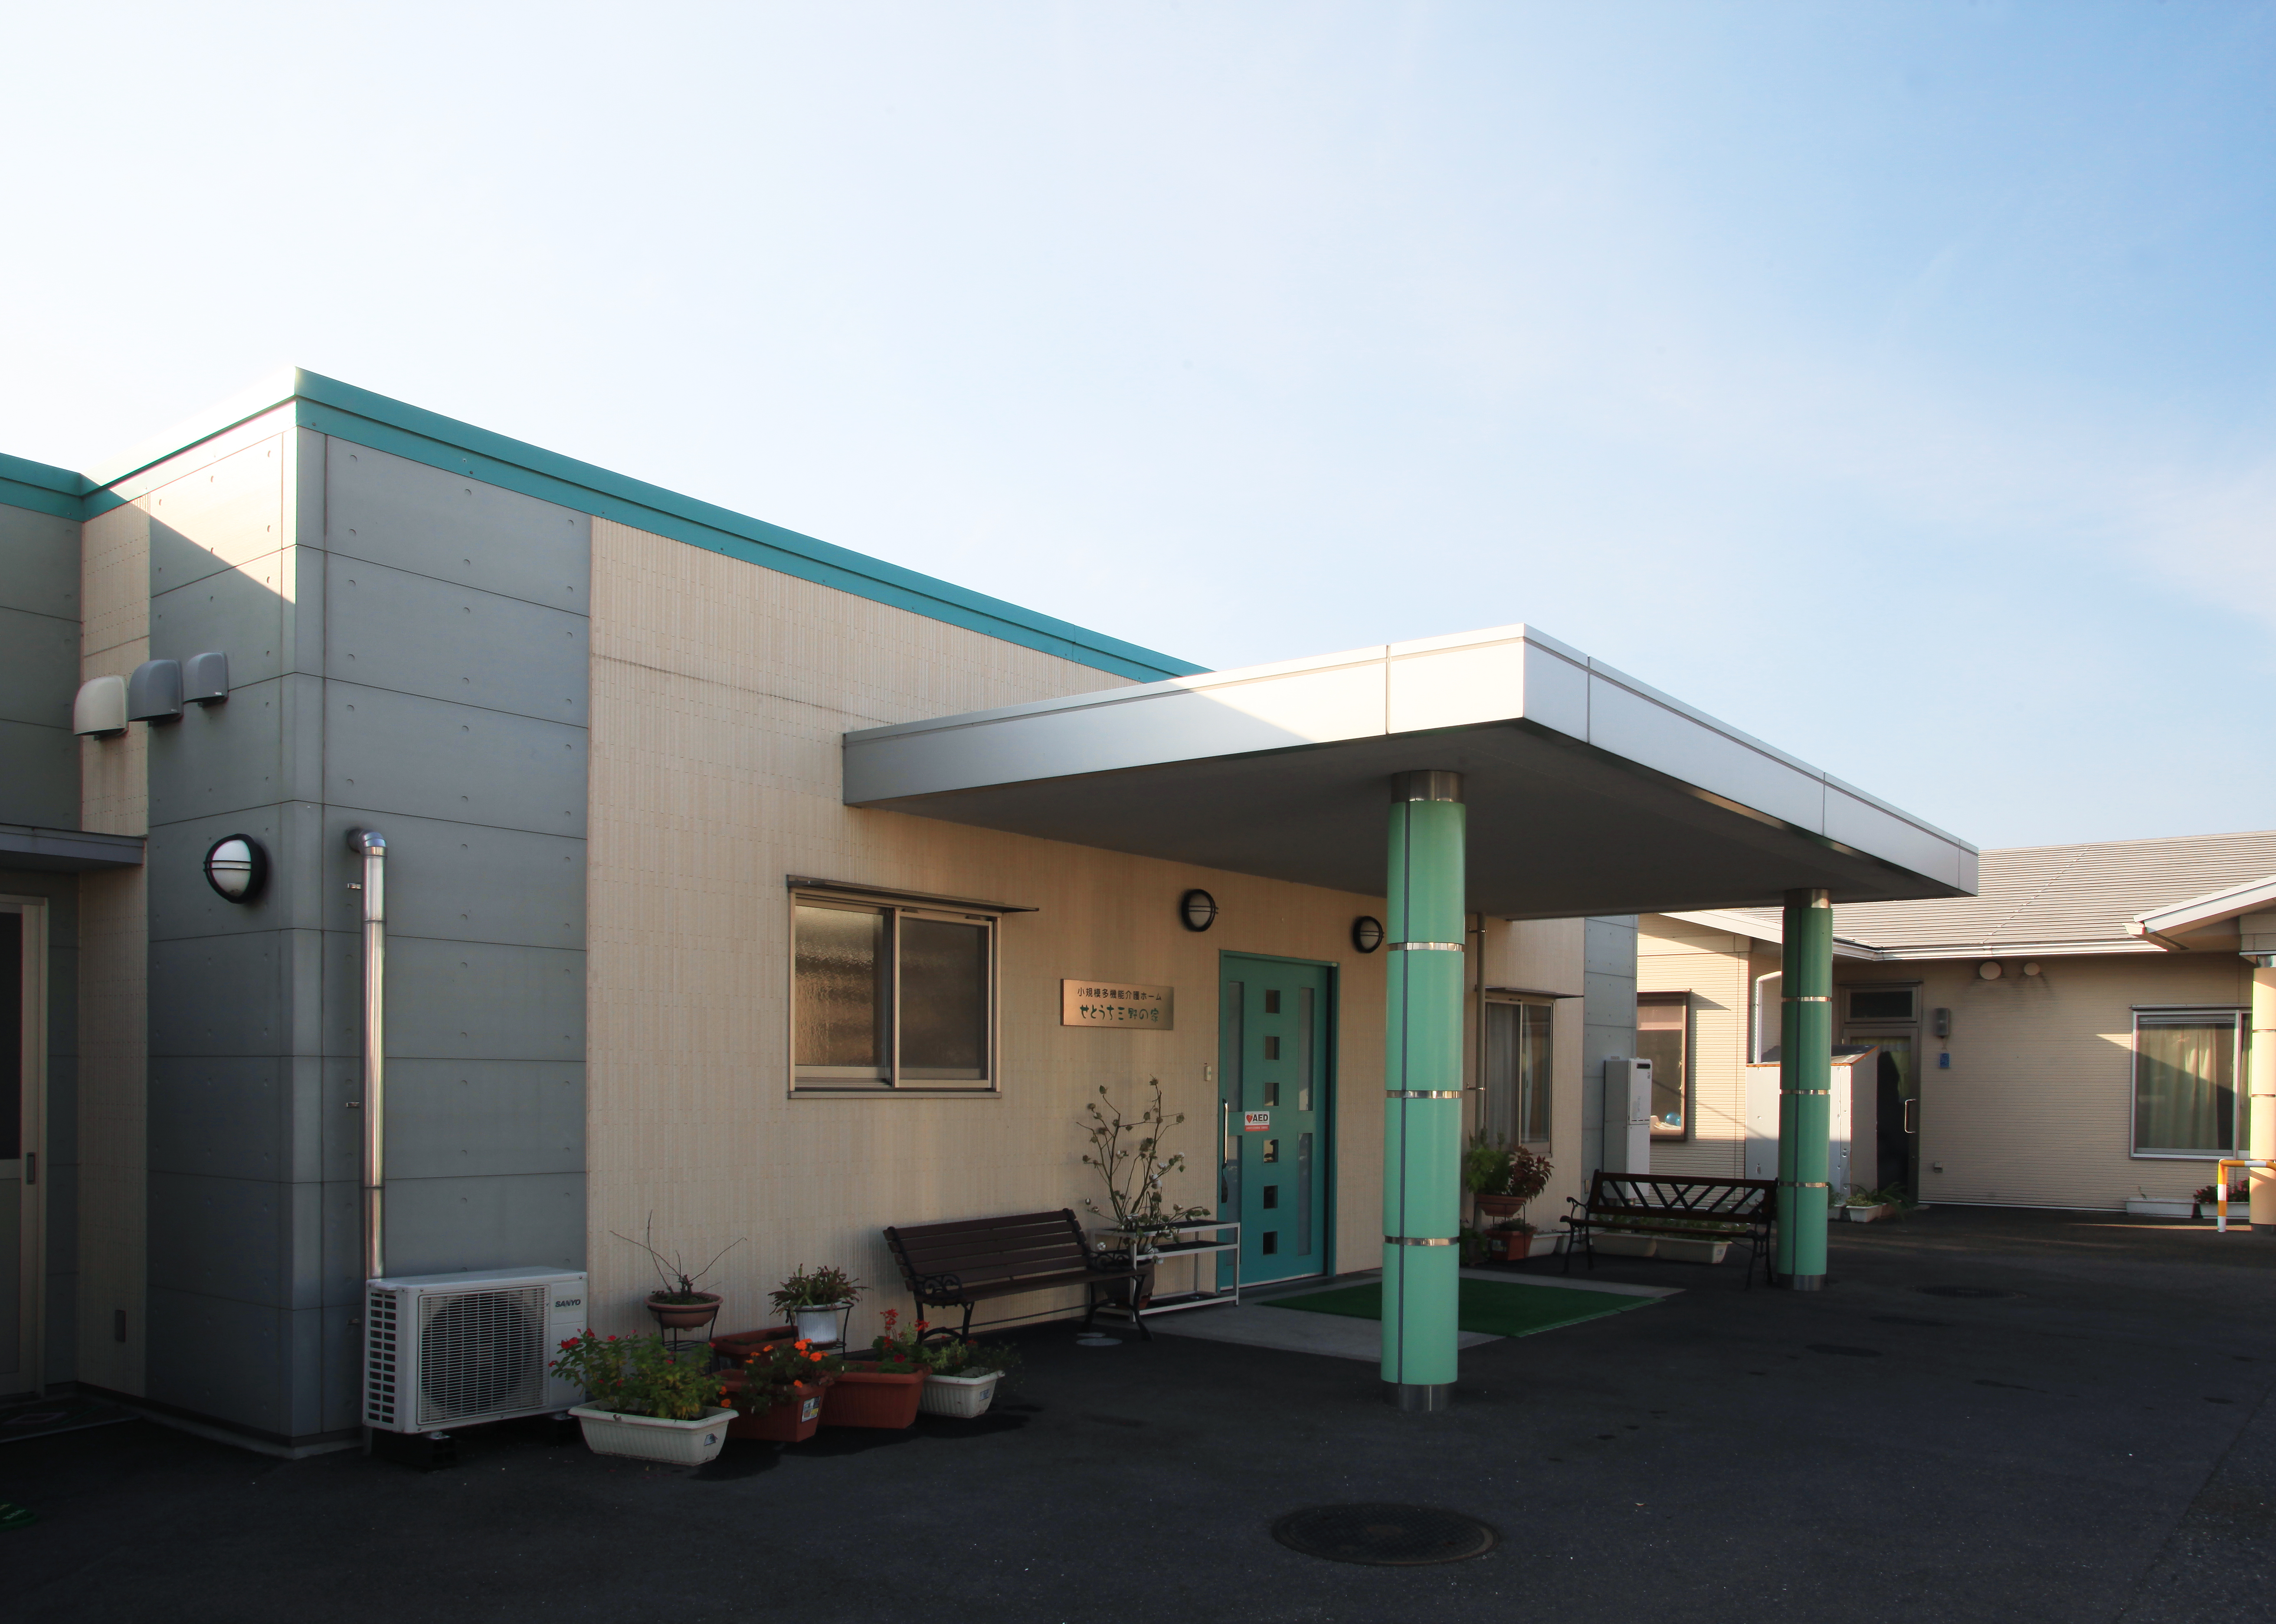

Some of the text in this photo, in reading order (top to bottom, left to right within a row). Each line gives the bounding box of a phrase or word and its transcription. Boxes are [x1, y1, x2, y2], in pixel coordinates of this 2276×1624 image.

[1077, 987, 1162, 1001] 小規模多機能介護ホーム
[1080, 1004, 1159, 1023] せとうち三野の家
[1252, 1113, 1268, 1122] AED
[555, 1299, 581, 1307] SANYO
